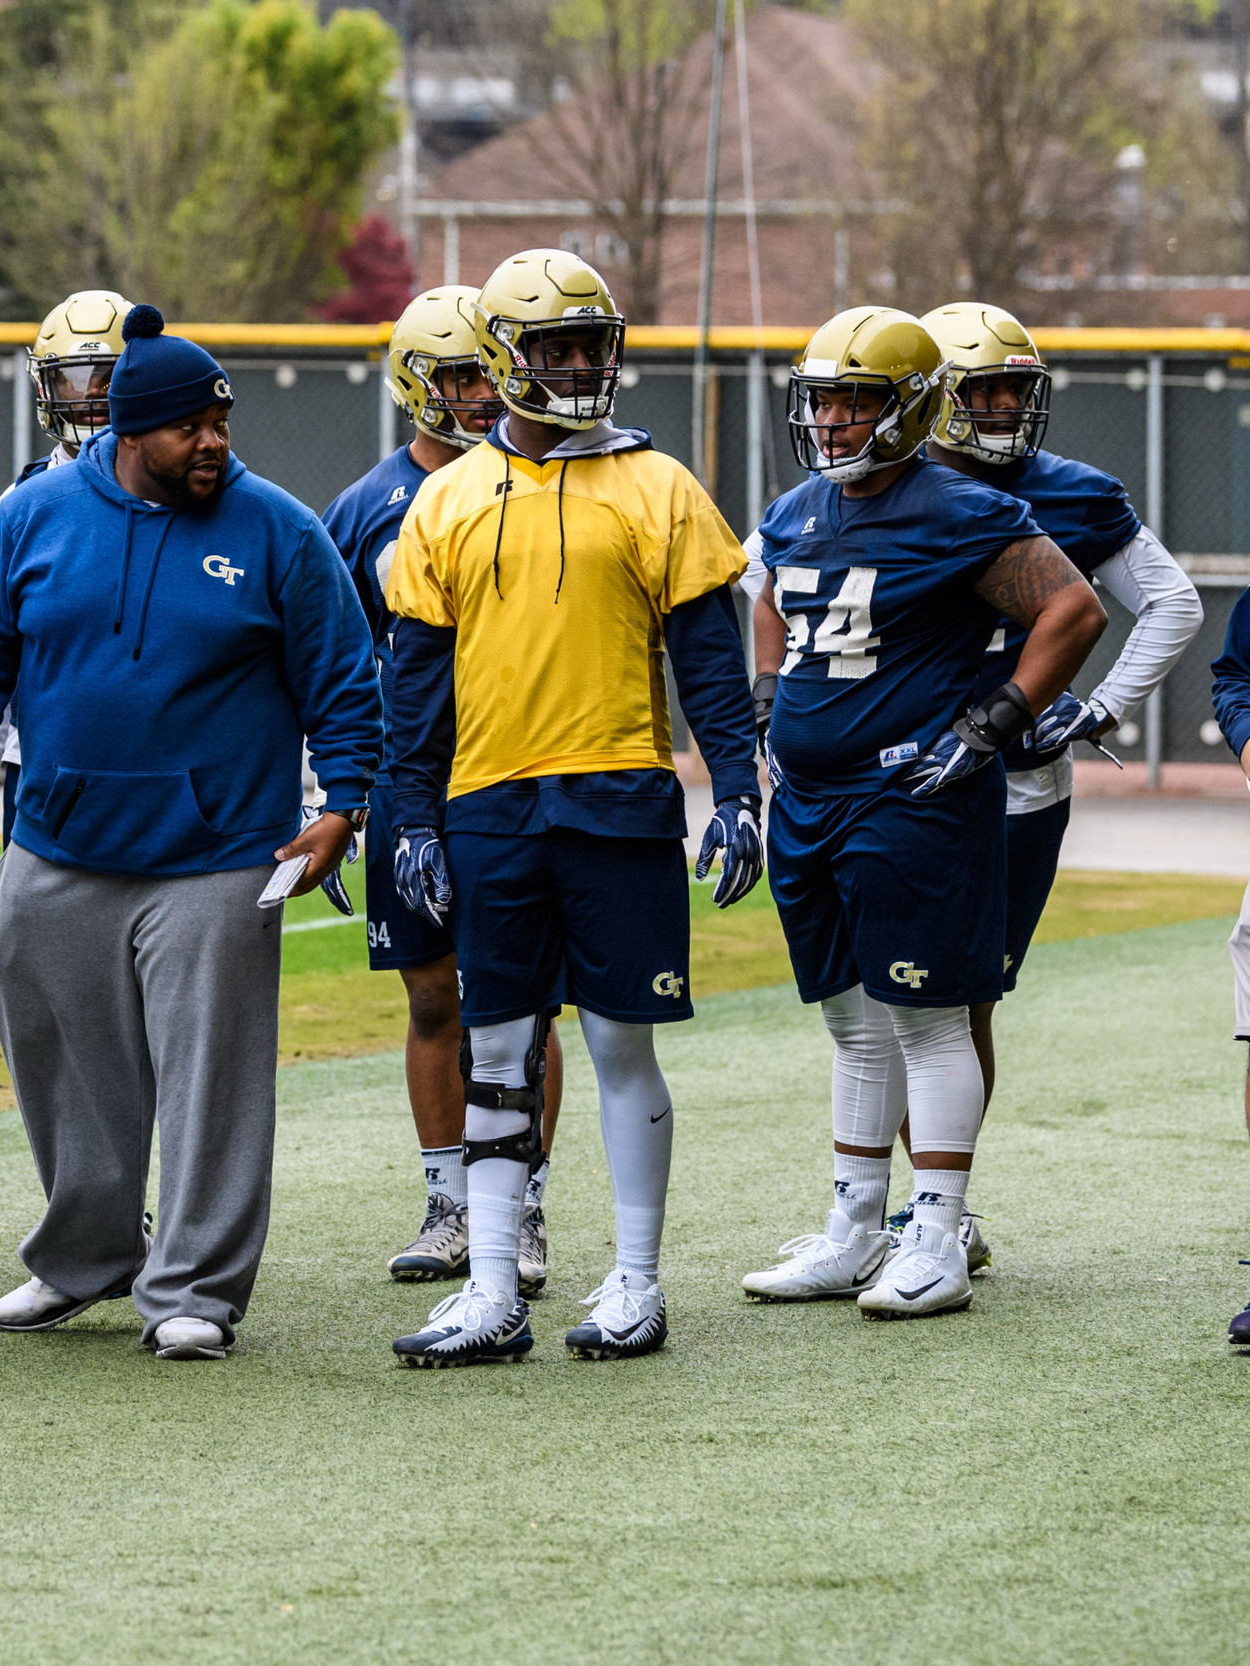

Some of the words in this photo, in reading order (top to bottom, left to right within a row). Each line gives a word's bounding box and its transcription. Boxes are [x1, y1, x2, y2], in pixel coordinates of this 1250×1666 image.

[577, 306, 597, 314] ACC
[203, 555, 244, 585] GT
[773, 566, 881, 679] 54
[900, 747, 917, 755] XXL
[367, 920, 391, 948] 94
[652, 971, 684, 998] GT
[889, 961, 929, 988] GT
